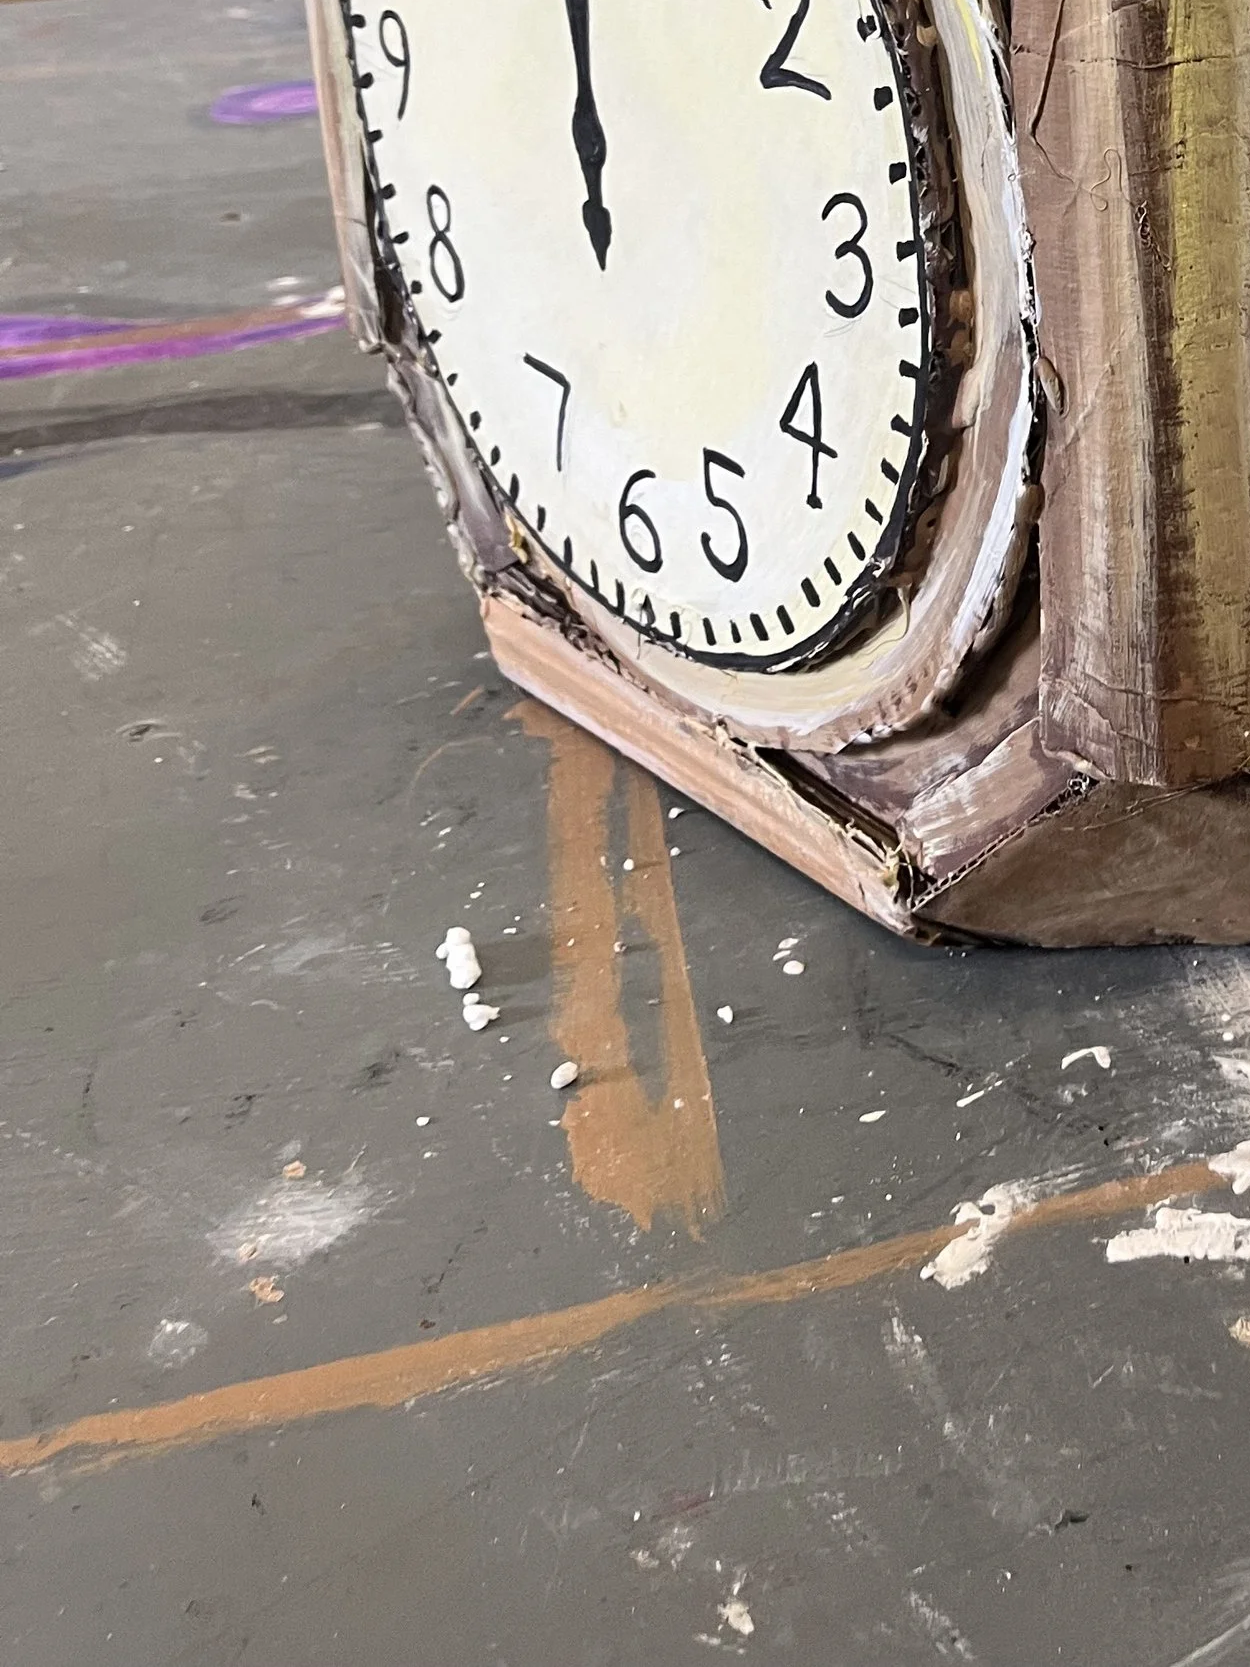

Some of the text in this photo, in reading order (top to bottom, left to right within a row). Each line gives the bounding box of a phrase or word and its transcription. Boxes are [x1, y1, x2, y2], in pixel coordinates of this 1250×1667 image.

[380, 10, 410, 119] 9
[427, 185, 464, 302] 8
[822, 193, 873, 318] 3
[524, 354, 570, 471] 7
[780, 362, 837, 509] 4
[619, 470, 663, 573] 6
[701, 448, 748, 582] 5
